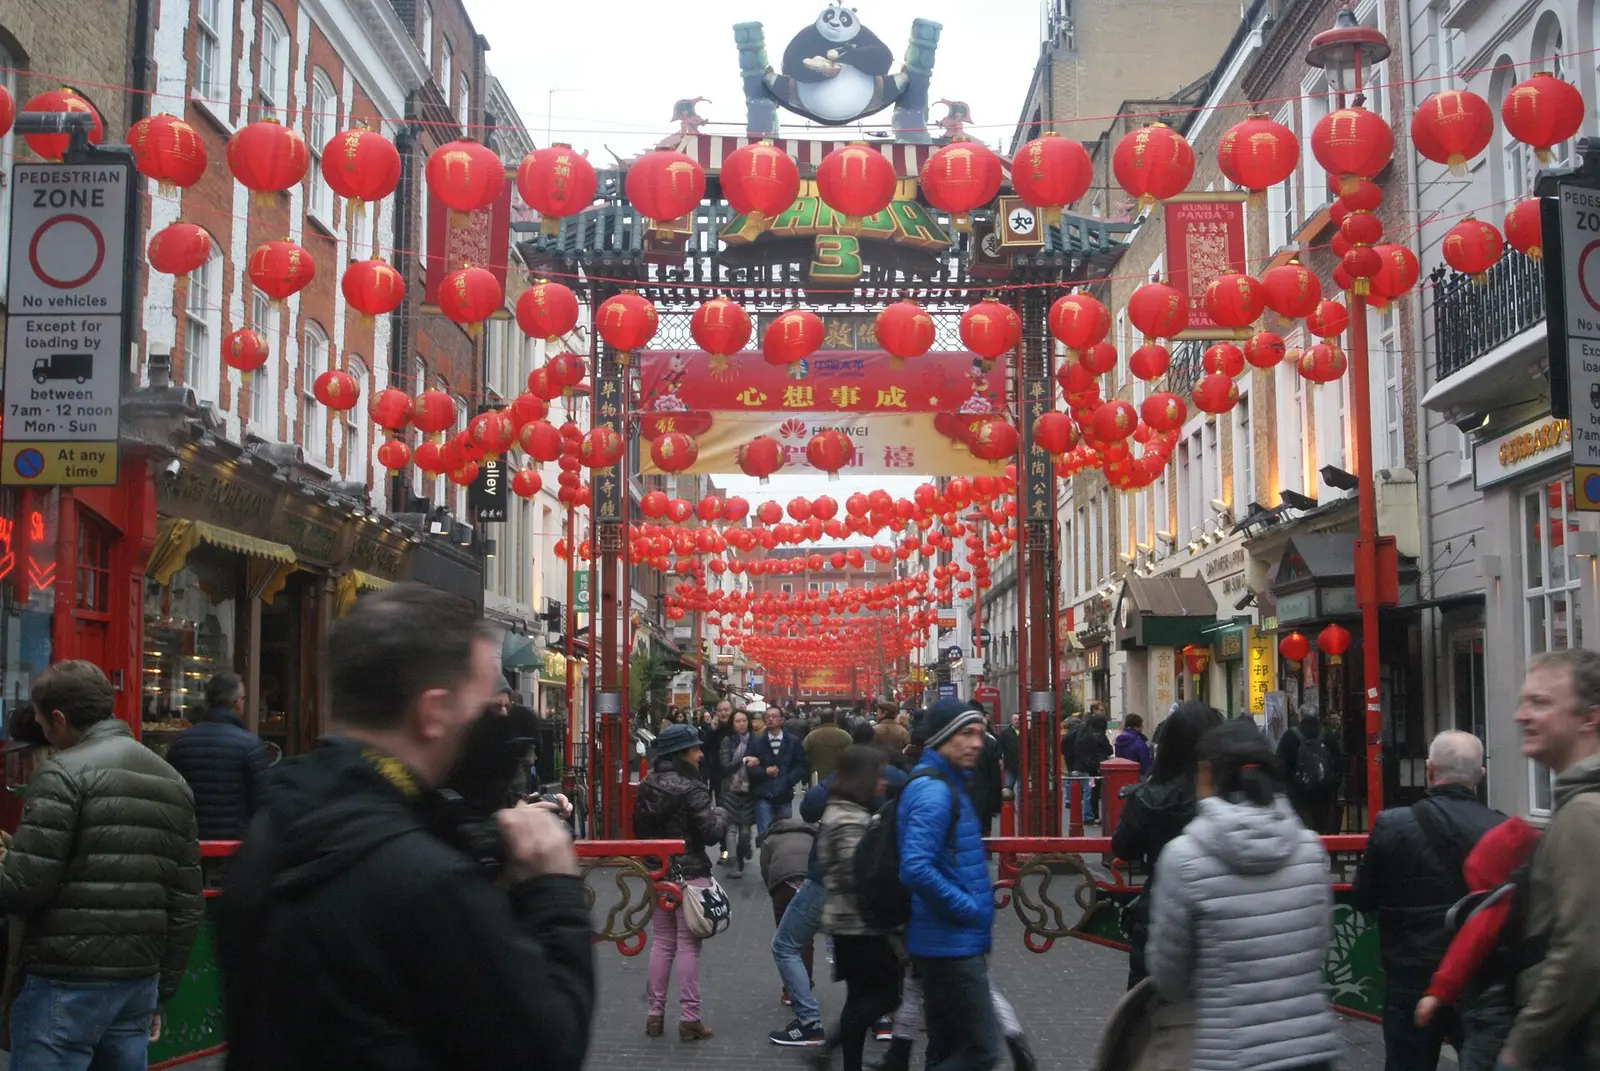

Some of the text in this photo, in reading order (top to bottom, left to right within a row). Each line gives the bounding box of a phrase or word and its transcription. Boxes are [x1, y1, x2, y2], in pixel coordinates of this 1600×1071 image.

[20, 171, 120, 184] PEDESTRIAN
[33, 189, 104, 208] ZONE
[1182, 203, 1211, 211] KUNG
[1011, 211, 1033, 230] 如
[1177, 211, 1234, 220] PANDA 3
[810, 234, 862, 278] 3
[23, 294, 107, 307] No vehicles
[27, 319, 102, 334] Except for
[1578, 318, 1593, 331] No
[25, 336, 101, 350] loading by
[30, 388, 93, 400] between
[736, 385, 907, 408] 心想事成
[10, 404, 42, 416] 7am
[56, 404, 72, 416] 12
[77, 406, 113, 417] noon
[24, 420, 55, 433] Mon
[68, 420, 97, 433] Sun
[57, 449, 106, 464] At any
[65, 465, 98, 477] time
